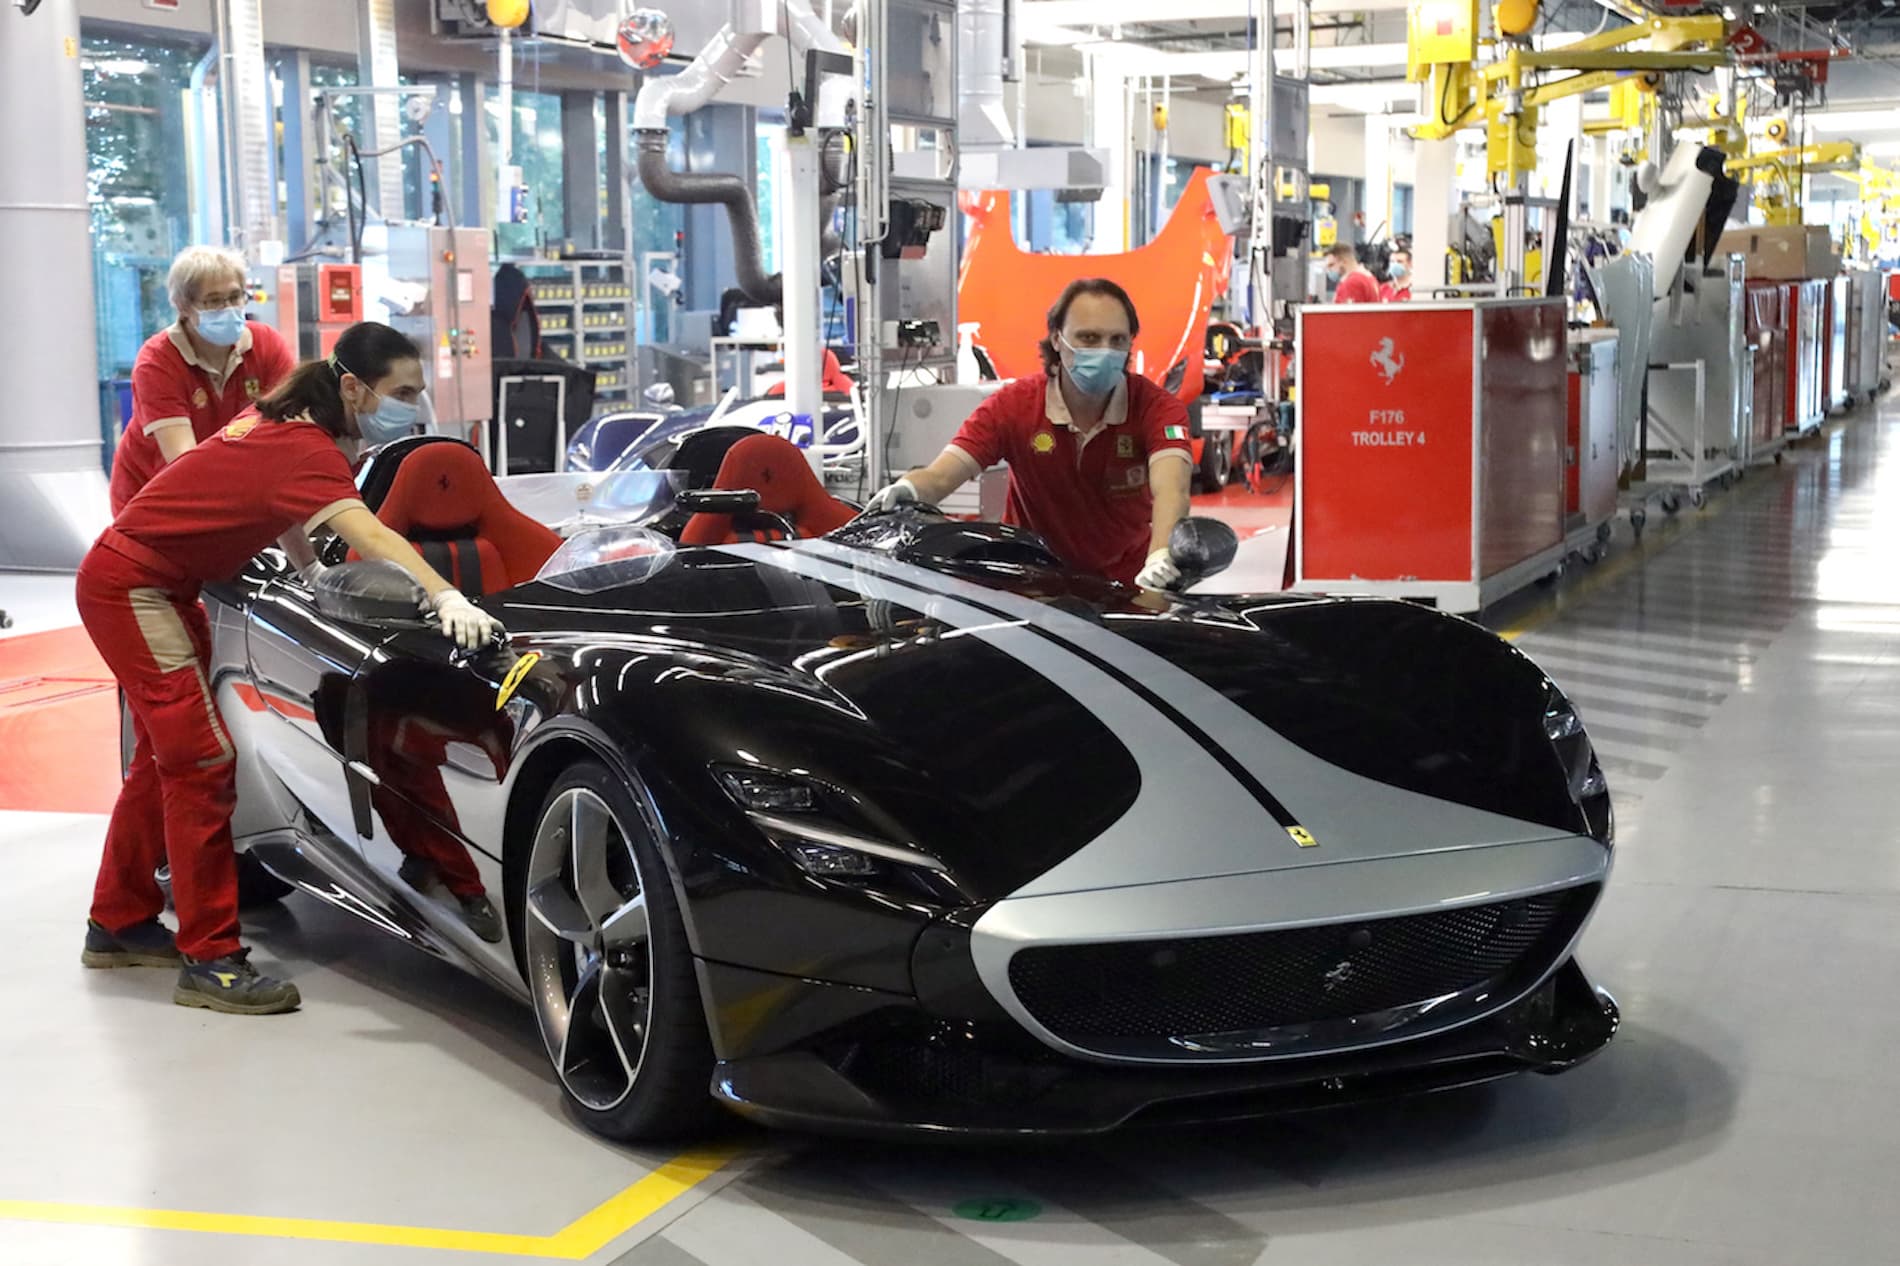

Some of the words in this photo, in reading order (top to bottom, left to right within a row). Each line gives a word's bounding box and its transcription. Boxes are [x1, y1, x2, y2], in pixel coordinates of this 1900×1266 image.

[1369, 409, 1405, 425] F176
[1351, 431, 1414, 447] TROLLEY
[1416, 431, 1426, 446] 4
